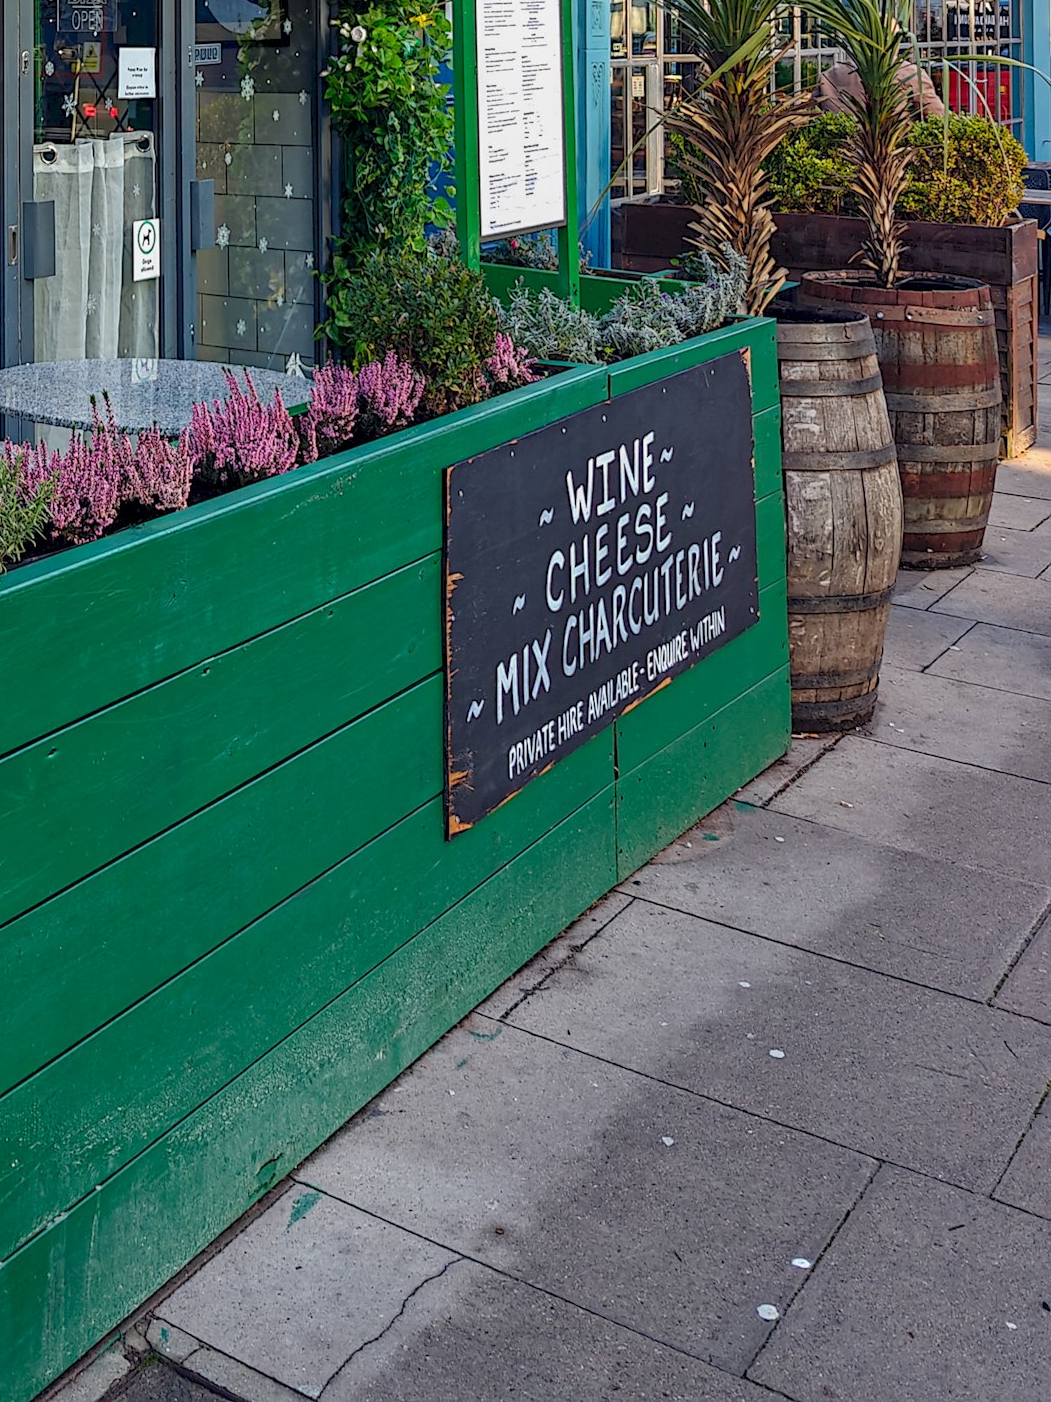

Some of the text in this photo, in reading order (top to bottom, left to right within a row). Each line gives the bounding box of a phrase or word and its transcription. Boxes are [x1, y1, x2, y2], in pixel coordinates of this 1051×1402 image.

[71, 8, 104, 30] OPEN
[566, 431, 655, 525] WINE
[546, 492, 672, 612] CHEESE
[496, 531, 724, 726] MIX CHARCUTERIE
[509, 720, 555, 780] PRIVATE
[557, 700, 584, 746] HIRE
[587, 661, 639, 725] AVAILABLE
[647, 630, 688, 682] ENQUIRE
[689, 606, 726, 653] WITHIN
